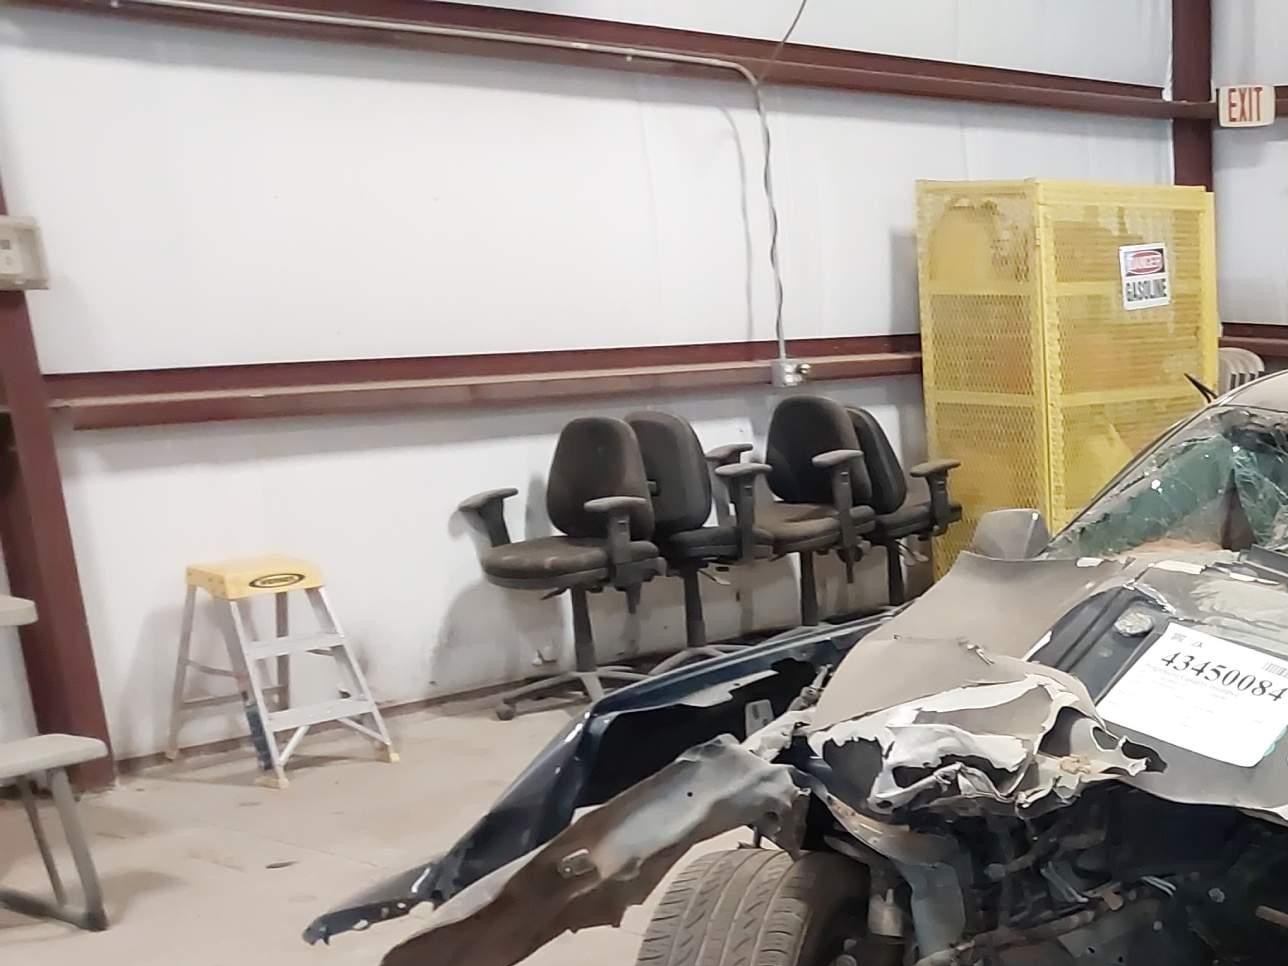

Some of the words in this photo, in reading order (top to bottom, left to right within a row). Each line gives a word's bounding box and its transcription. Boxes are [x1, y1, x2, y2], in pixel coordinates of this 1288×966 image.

[1228, 87, 1263, 122] EXIT
[1126, 278, 1167, 302] GASOLINE
[1161, 652, 1288, 702] 43450084
